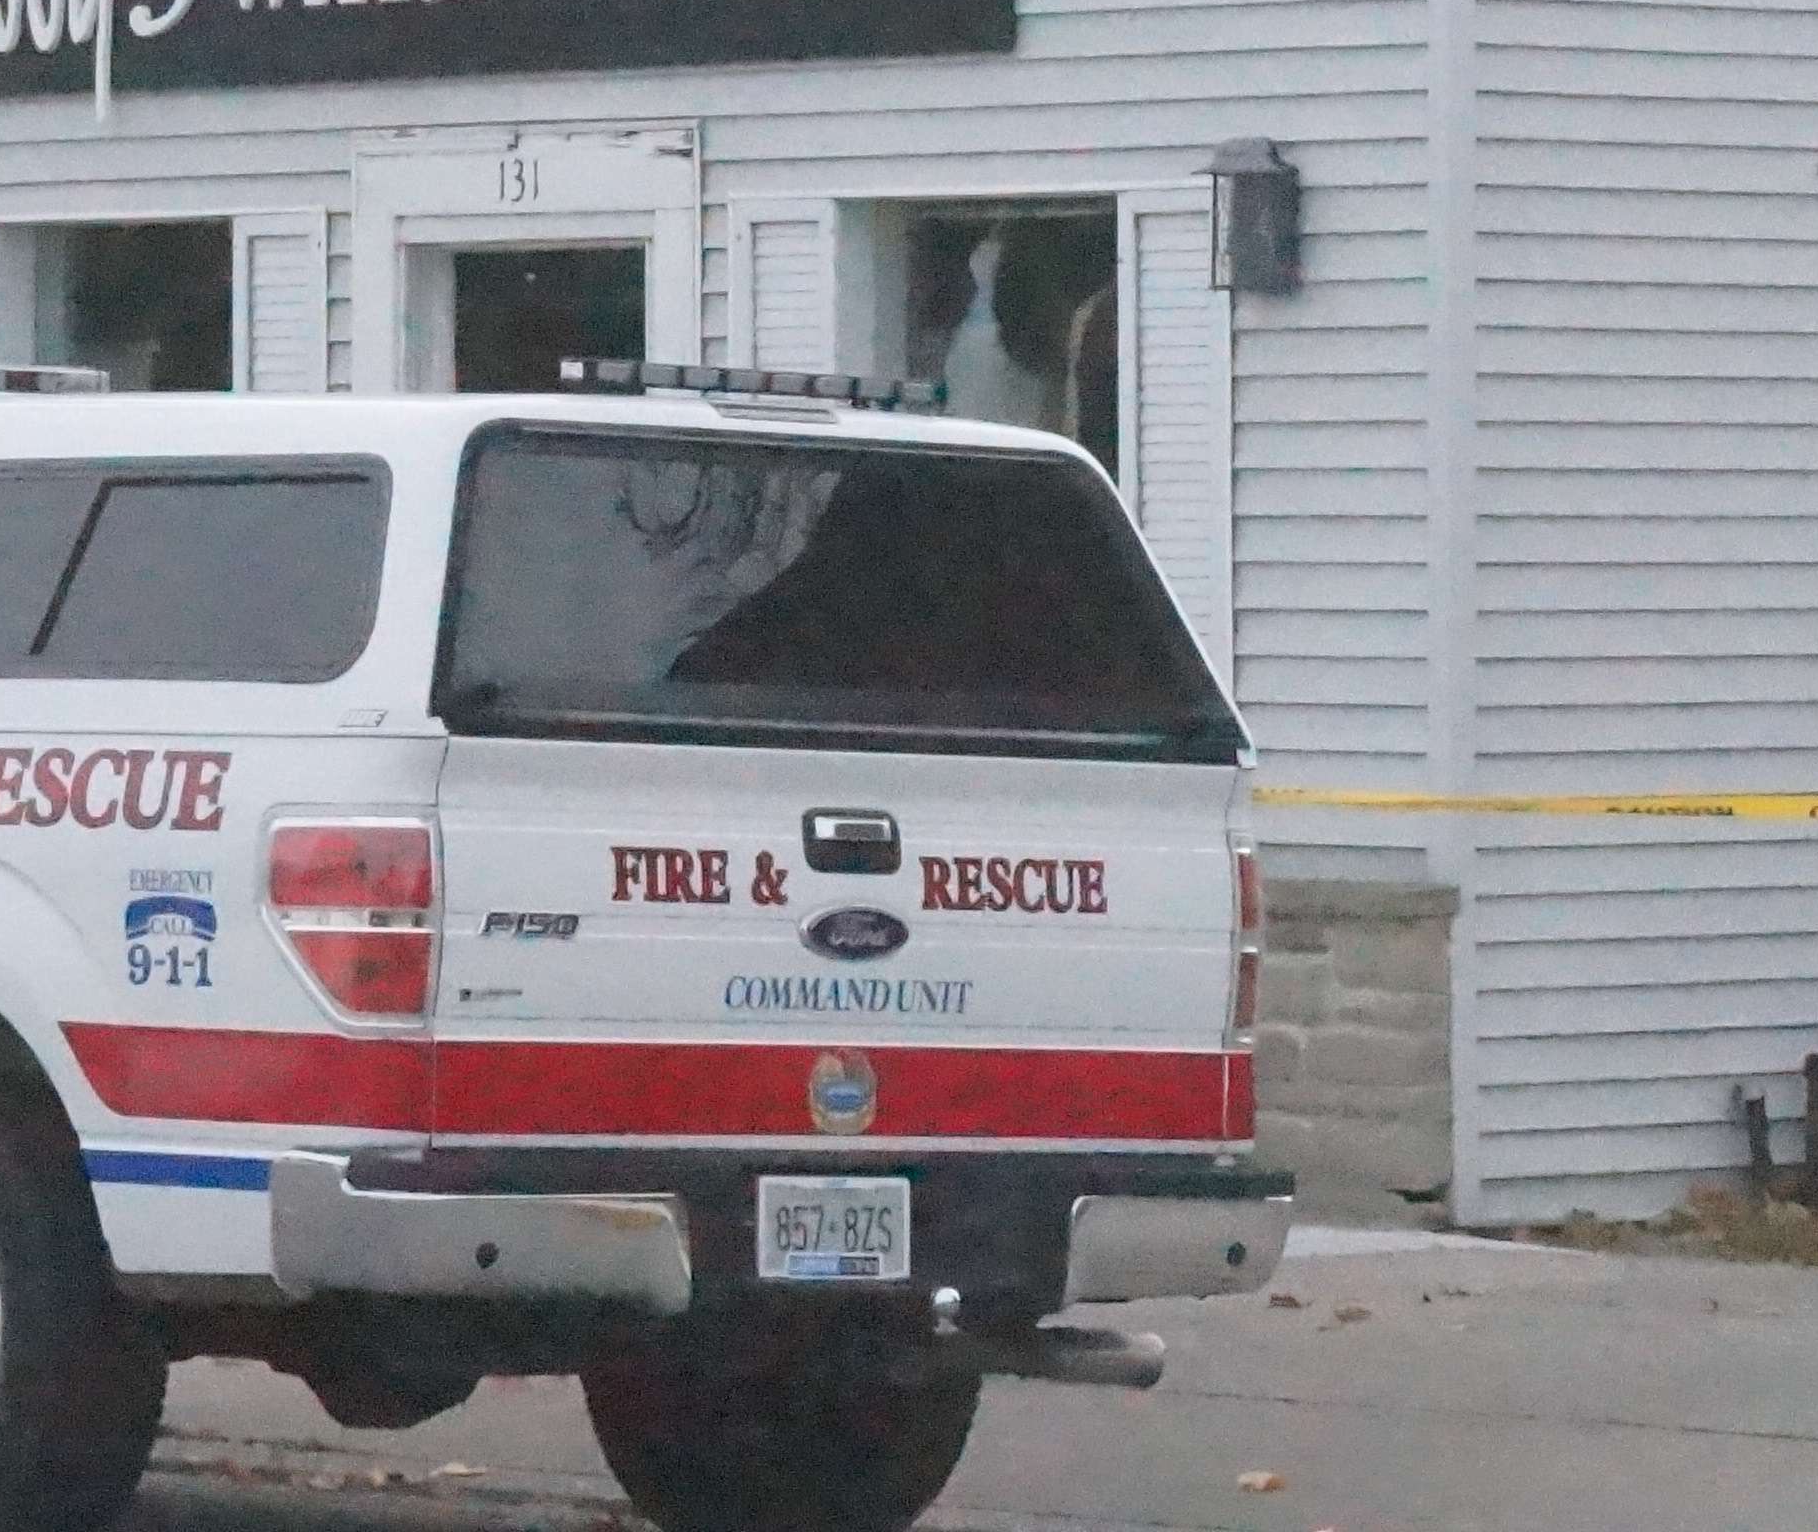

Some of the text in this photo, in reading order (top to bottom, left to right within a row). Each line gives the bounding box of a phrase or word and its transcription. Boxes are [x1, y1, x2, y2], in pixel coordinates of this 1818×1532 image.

[499, 158, 539, 202] 131
[611, 846, 789, 906] FIRE &
[919, 856, 1108, 915] RESCUE
[127, 943, 213, 986] 9-1-1
[724, 974, 974, 1015] COMMAND UNIT
